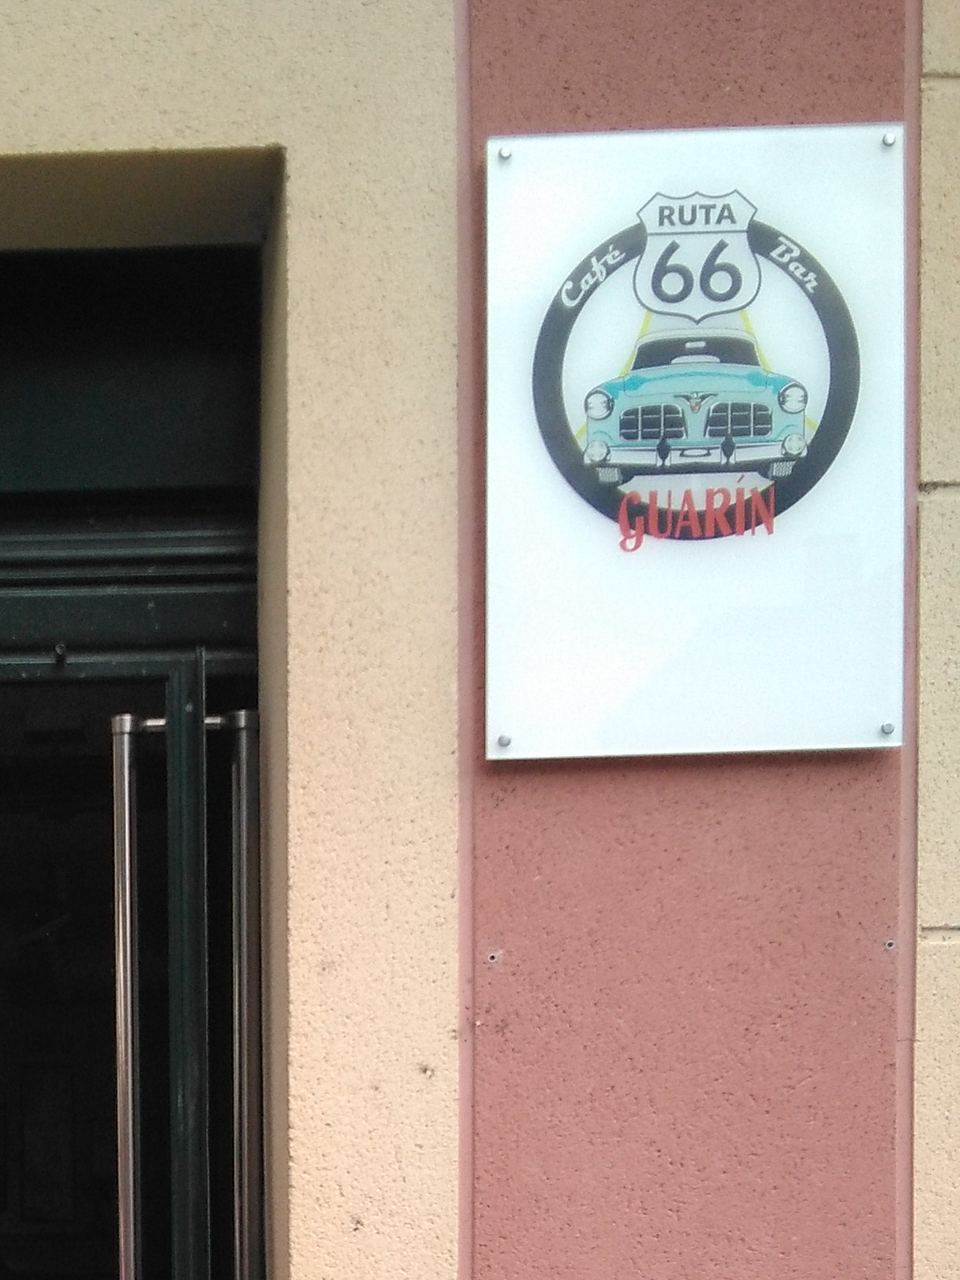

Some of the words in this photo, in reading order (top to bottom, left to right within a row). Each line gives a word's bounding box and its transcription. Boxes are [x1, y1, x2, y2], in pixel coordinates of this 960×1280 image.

[658, 204, 736, 226] RUTA
[561, 244, 626, 307] Café
[770, 237, 818, 294] Bar
[651, 240, 742, 303] 66
[618, 475, 776, 551] GUARÍN
